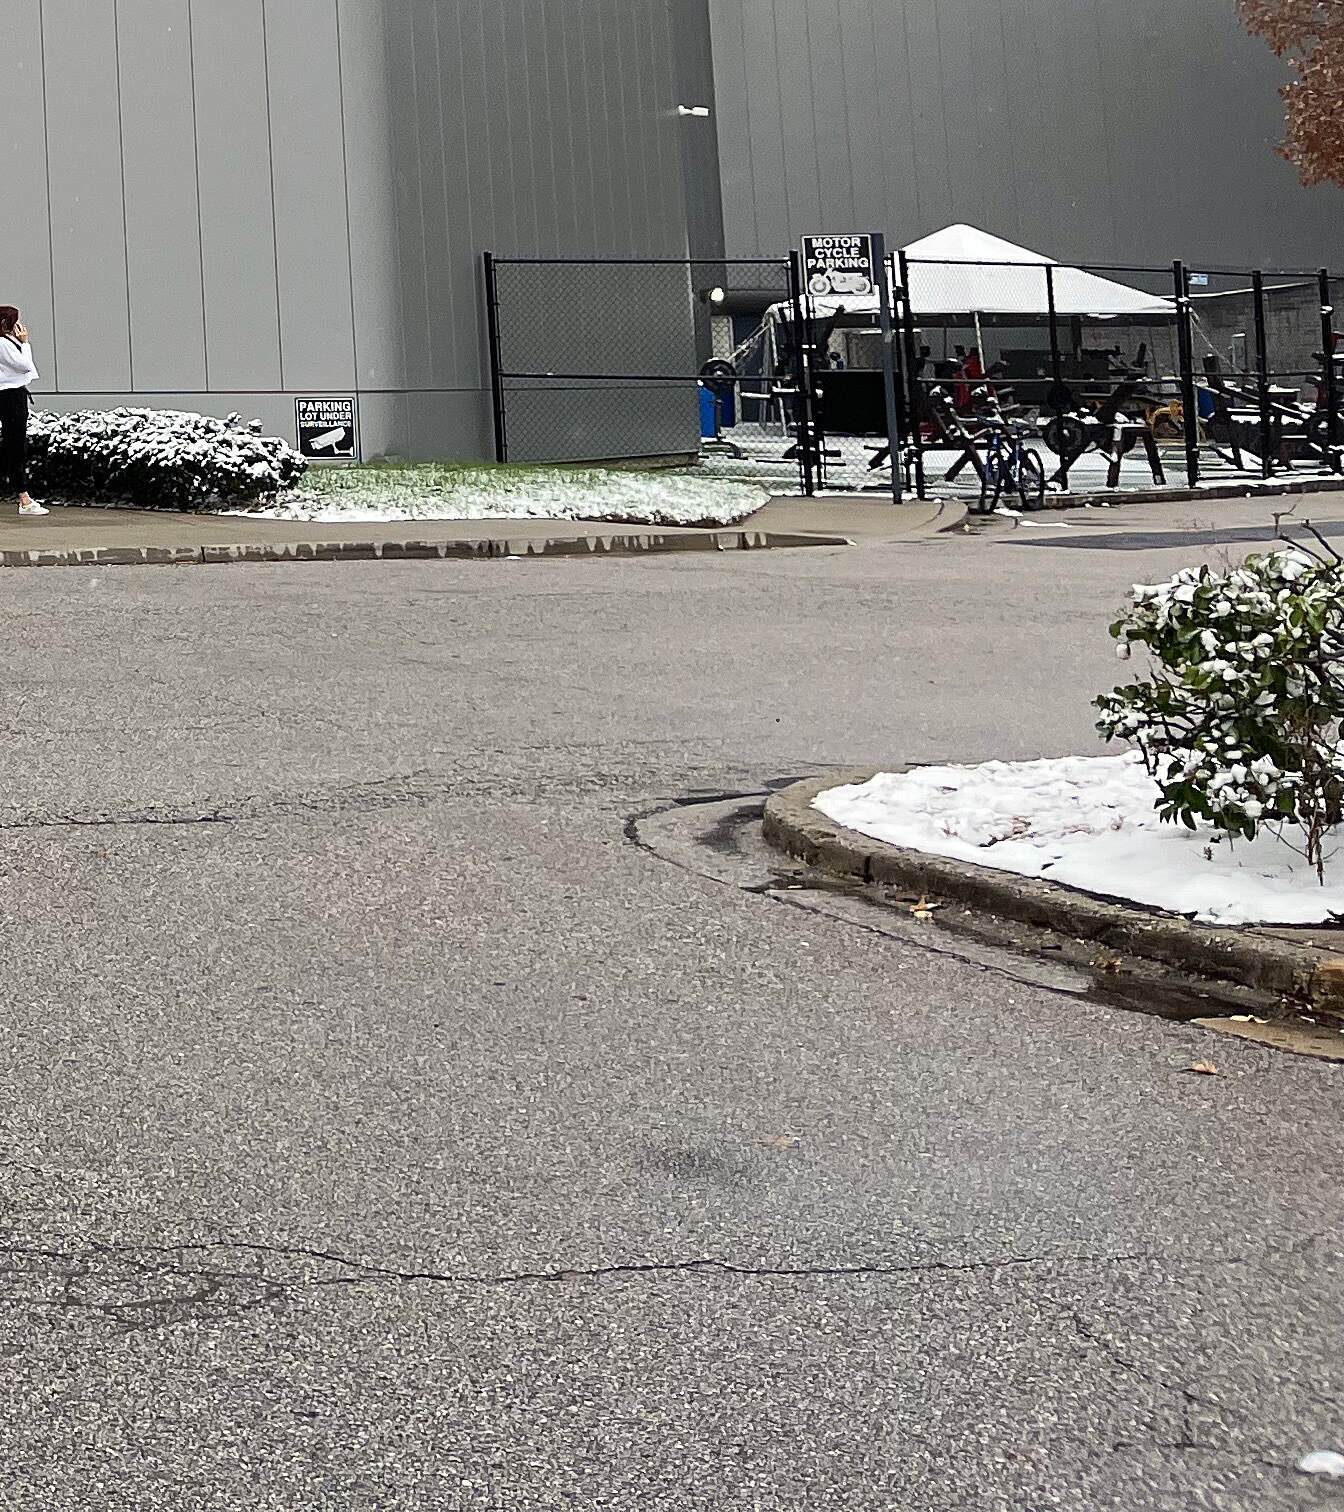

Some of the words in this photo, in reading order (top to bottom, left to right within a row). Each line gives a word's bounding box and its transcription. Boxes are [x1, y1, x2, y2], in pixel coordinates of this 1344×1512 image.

[812, 237, 861, 248] MOTOR
[814, 248, 860, 258] CYCLE
[807, 257, 869, 269] PARKING
[299, 401, 351, 412] PARKING
[299, 412, 318, 420] LOT
[319, 411, 352, 420] UNDER
